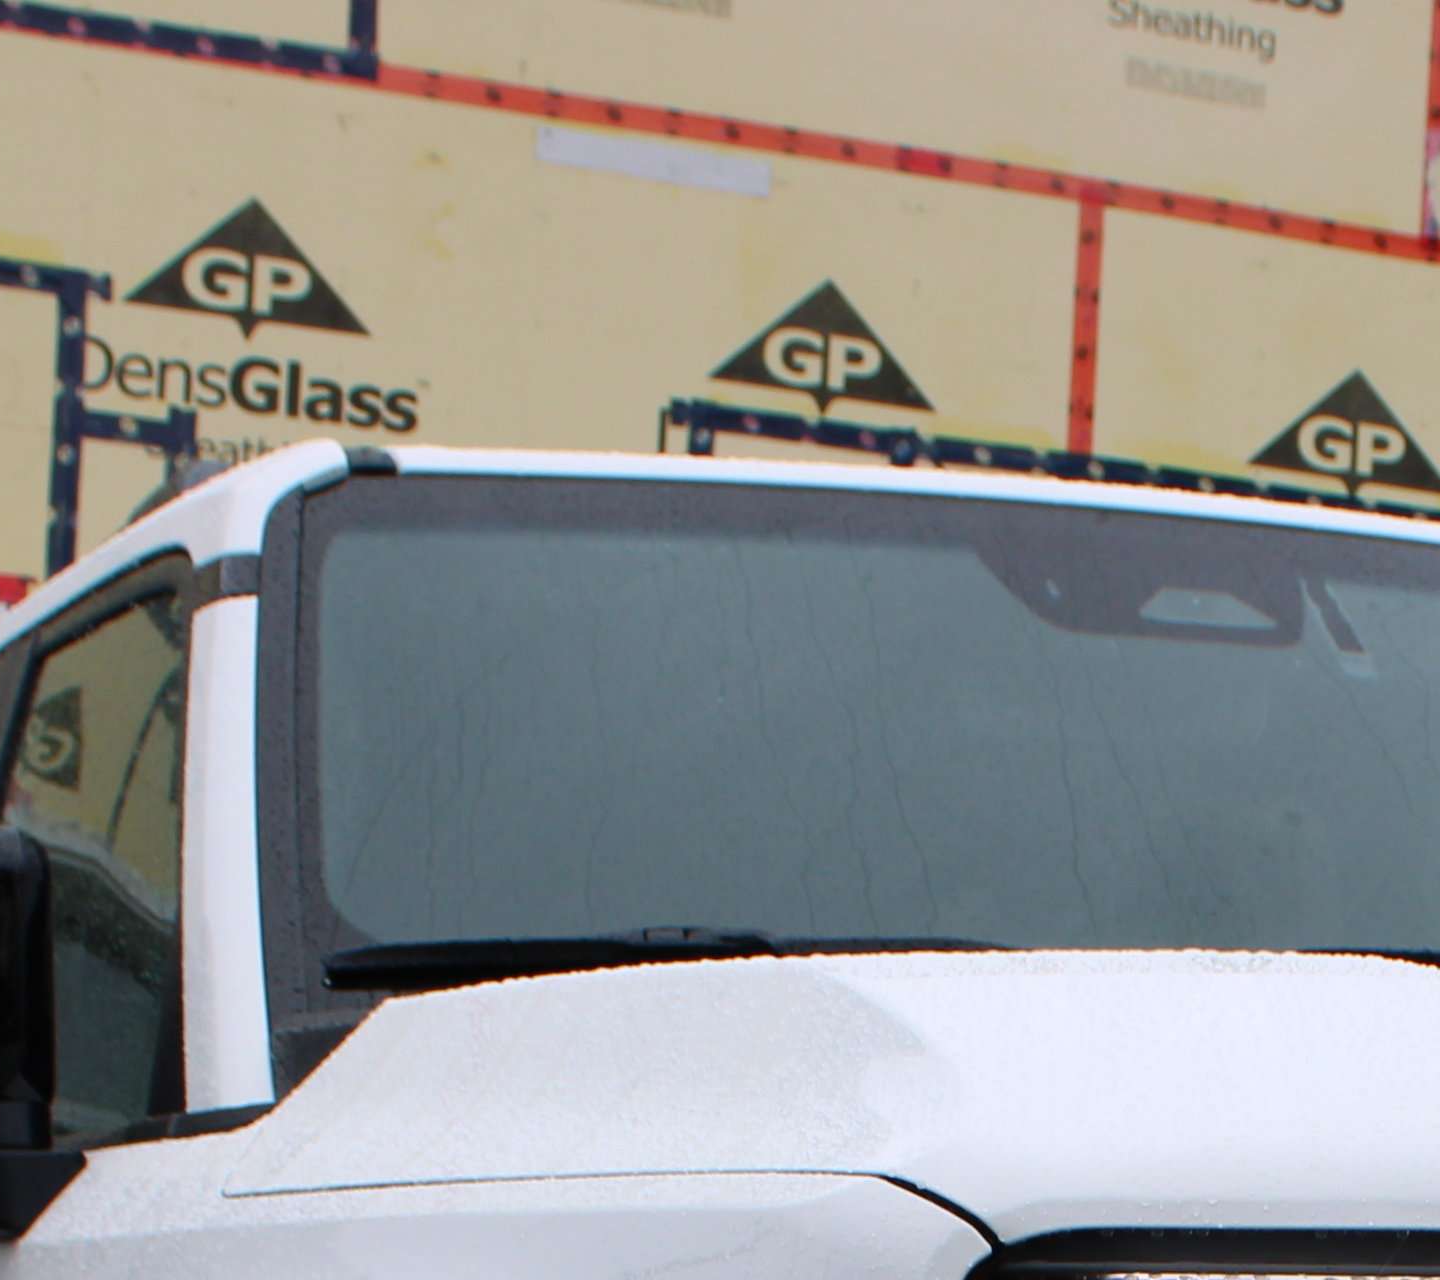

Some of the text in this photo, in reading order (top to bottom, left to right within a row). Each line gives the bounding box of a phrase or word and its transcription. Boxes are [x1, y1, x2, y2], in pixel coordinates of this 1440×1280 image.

[1108, 0, 1277, 63] Sheathing
[180, 246, 313, 317] GP
[762, 326, 884, 394] GP
[1295, 412, 1407, 479] GP
